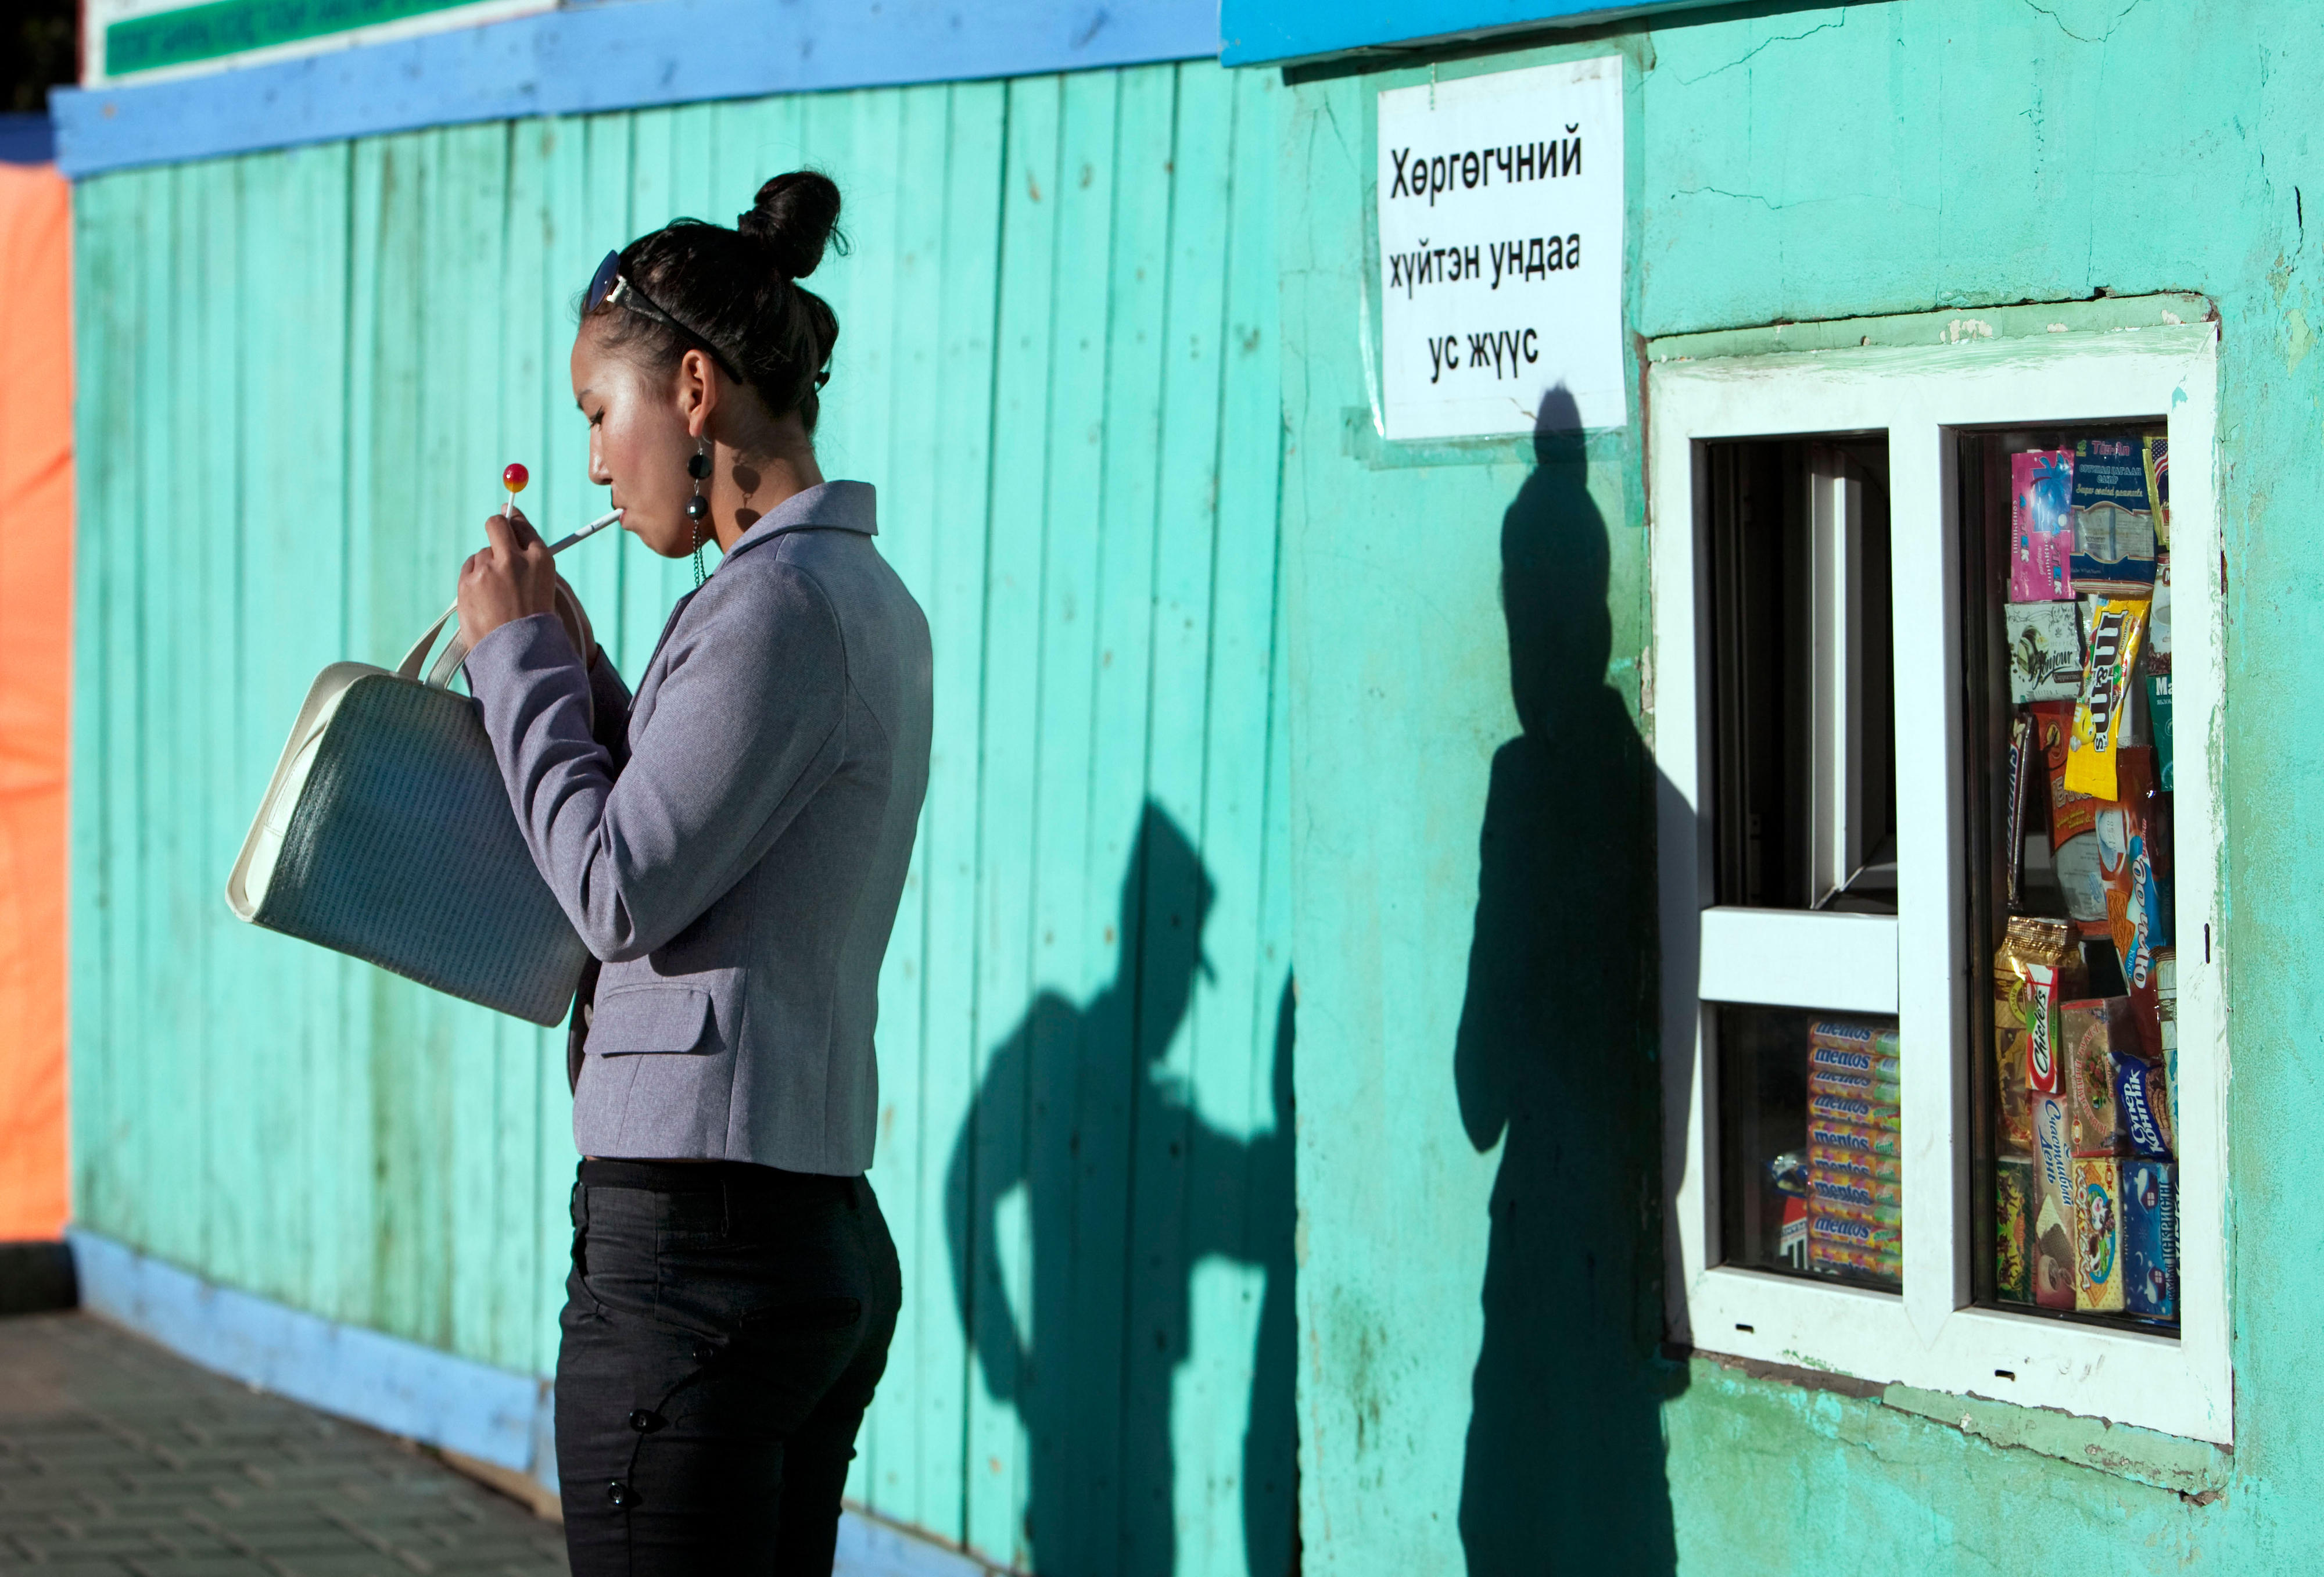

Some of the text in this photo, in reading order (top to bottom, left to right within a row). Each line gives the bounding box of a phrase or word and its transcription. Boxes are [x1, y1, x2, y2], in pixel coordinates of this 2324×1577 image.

[1391, 123, 1581, 207] Хөргөгчний
[1390, 234, 1580, 299] хүйтэн ундаа
[1429, 328, 1538, 384] ус жүүс
[2028, 650, 2073, 690] Bonjour
[2092, 610, 2129, 752] m&m's
[1814, 1048, 1871, 1069] mentos
[2033, 990, 2049, 1074] Chiclets
[1814, 1095, 1870, 1115] mentos
[2124, 1083, 2146, 1144] Супер
[1814, 1130, 1869, 1151] mentos
[2038, 1125, 2057, 1184] День
[2045, 1099, 2074, 1207] Счастливый
[1814, 1181, 1872, 1206] mentos
[1814, 1218, 1870, 1239] mentos
